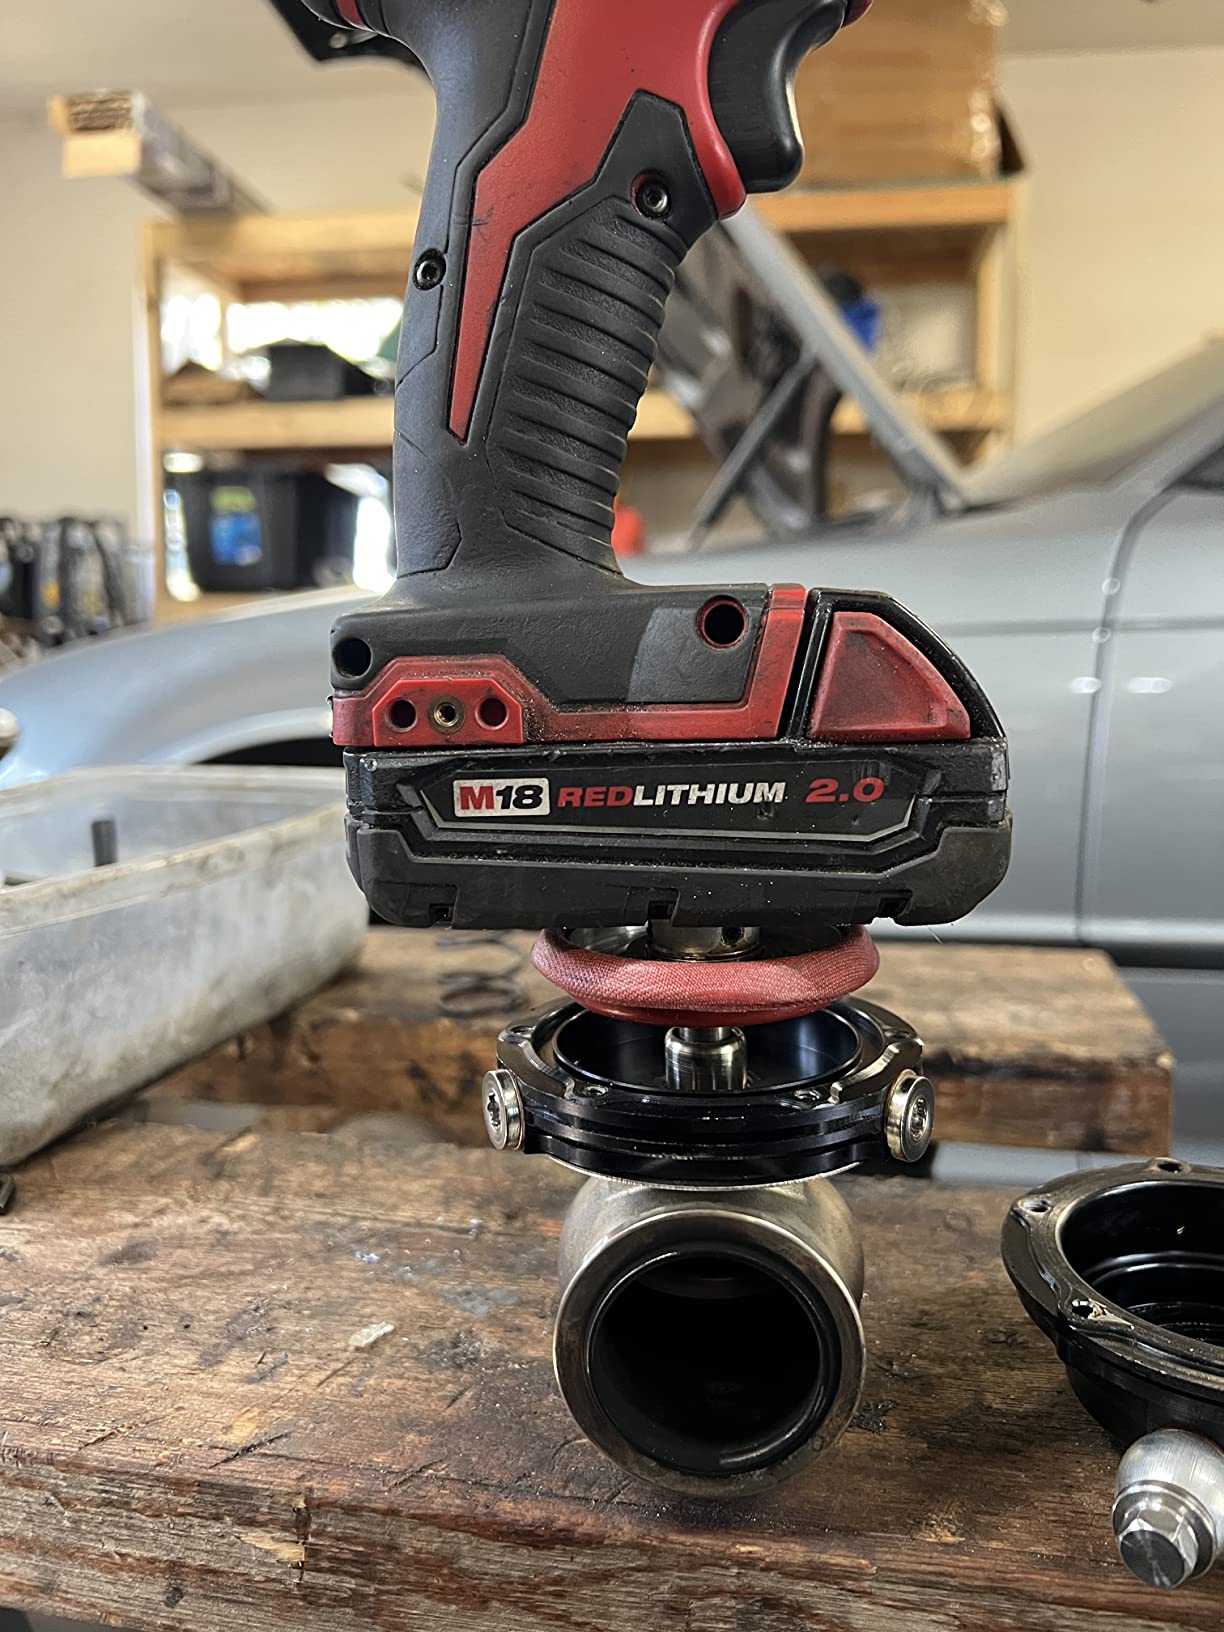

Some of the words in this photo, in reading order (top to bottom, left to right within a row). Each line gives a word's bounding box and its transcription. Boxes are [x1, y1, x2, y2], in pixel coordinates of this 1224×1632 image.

[459, 785, 544, 810] M18
[557, 782, 786, 808] REDLITHIUM
[805, 778, 885, 804] 2.0
